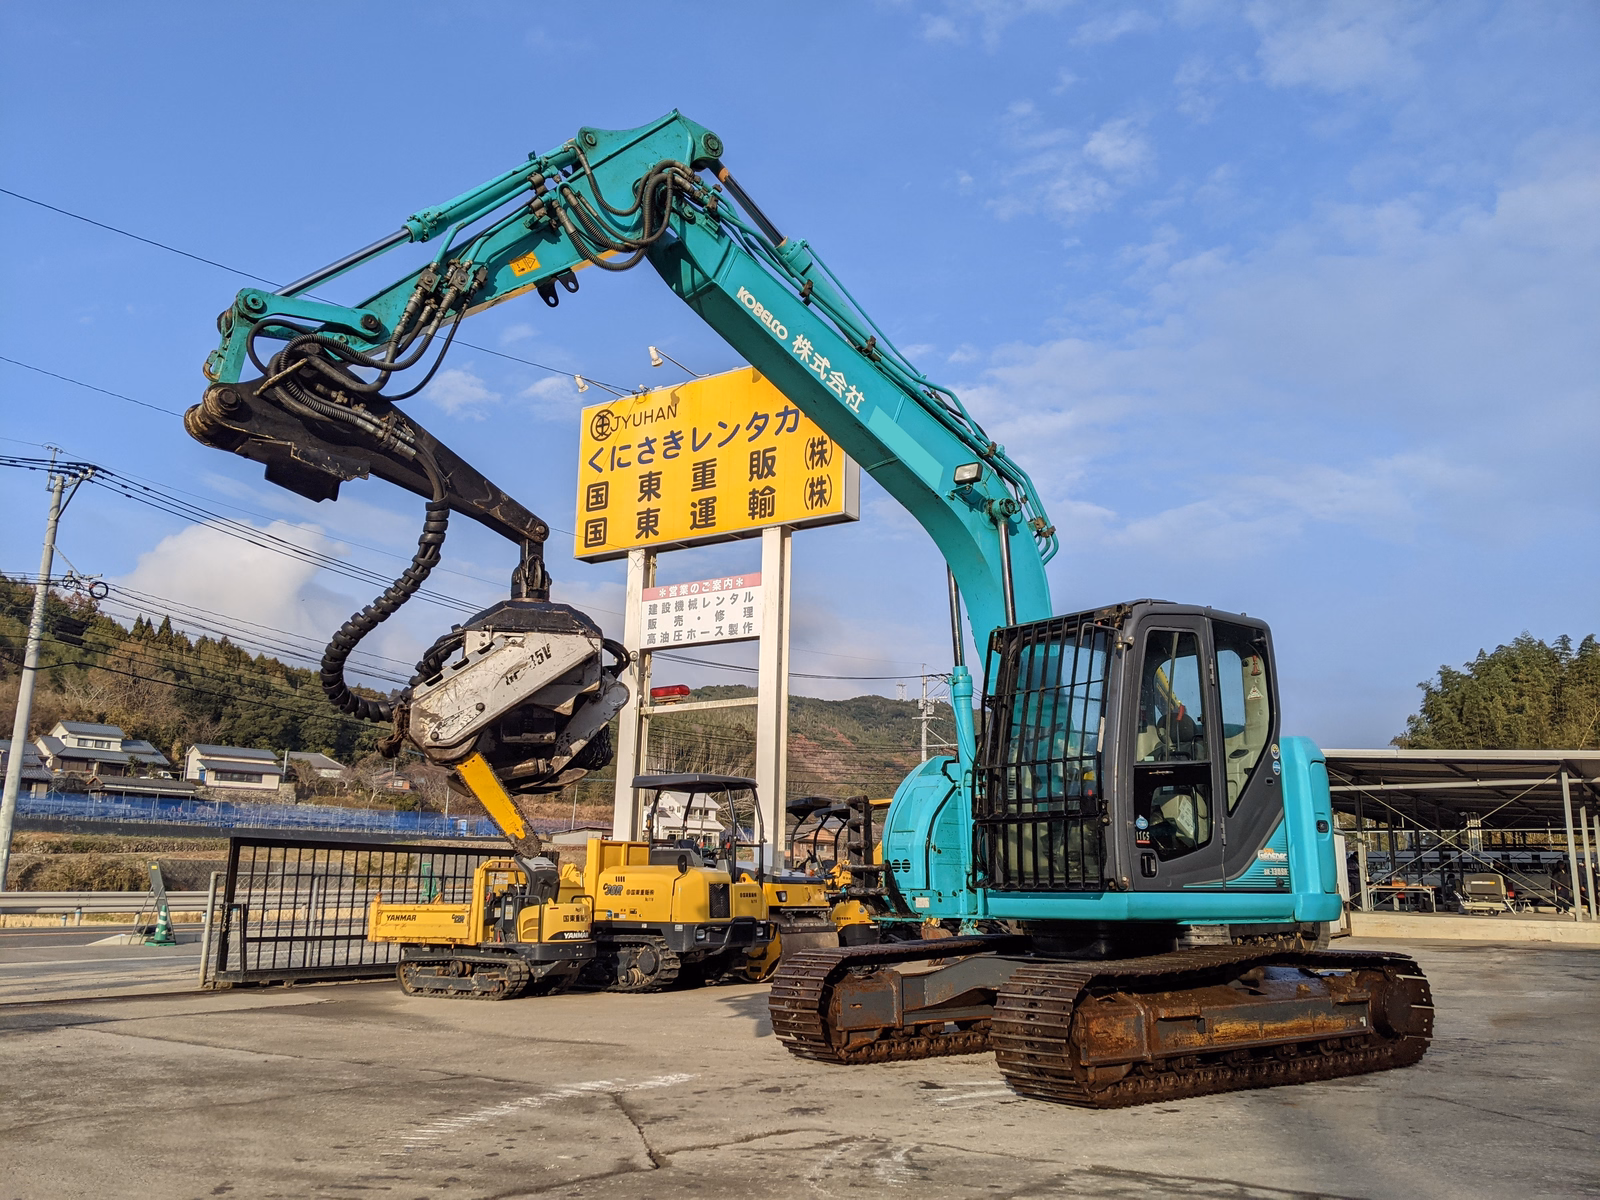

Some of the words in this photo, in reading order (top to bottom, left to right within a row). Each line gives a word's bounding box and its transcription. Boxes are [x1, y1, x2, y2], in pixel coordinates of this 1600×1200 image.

[736, 285, 789, 341] KOBELCO
[792, 334, 866, 414] 株式会社
[610, 403, 678, 433] JYUHAN
[588, 405, 808, 474] くにさきレンタカ
[648, 591, 754, 616] 建設機械レンタル
[646, 621, 754, 645] 高油圧ホース製作
[386, 914, 417, 922] YANMAR
